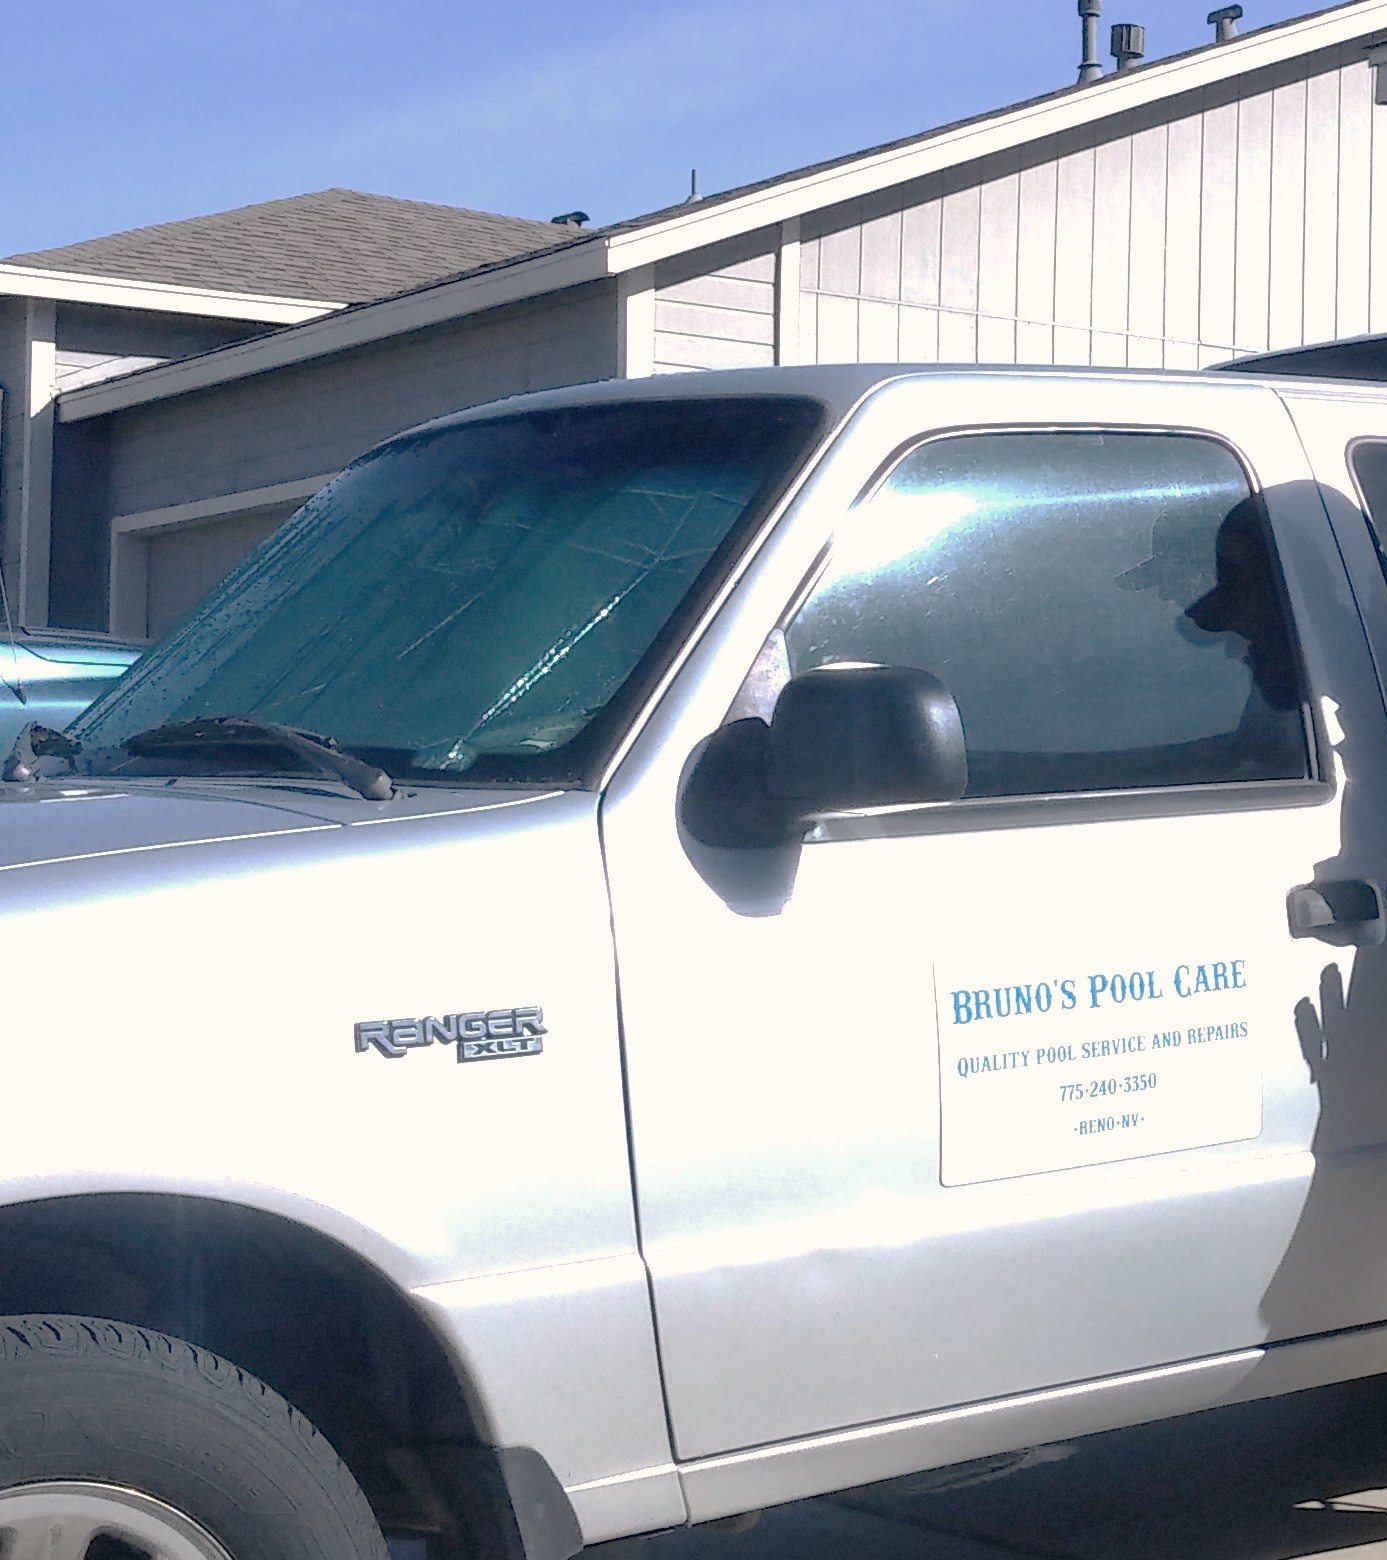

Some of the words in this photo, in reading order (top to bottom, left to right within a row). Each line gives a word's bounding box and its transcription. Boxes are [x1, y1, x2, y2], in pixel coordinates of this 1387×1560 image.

[950, 978, 1077, 1025] BRUNO'S
[1087, 970, 1163, 1009] POOL
[1173, 959, 1247, 998] CARE
[471, 1038, 536, 1056] XLT
[957, 1050, 1031, 1078] QUALITY
[1036, 1044, 1077, 1065] POOL
[1081, 1035, 1146, 1059] SERVICE
[1151, 1030, 1182, 1050] AND
[1187, 1021, 1249, 1045] REPAIRS
